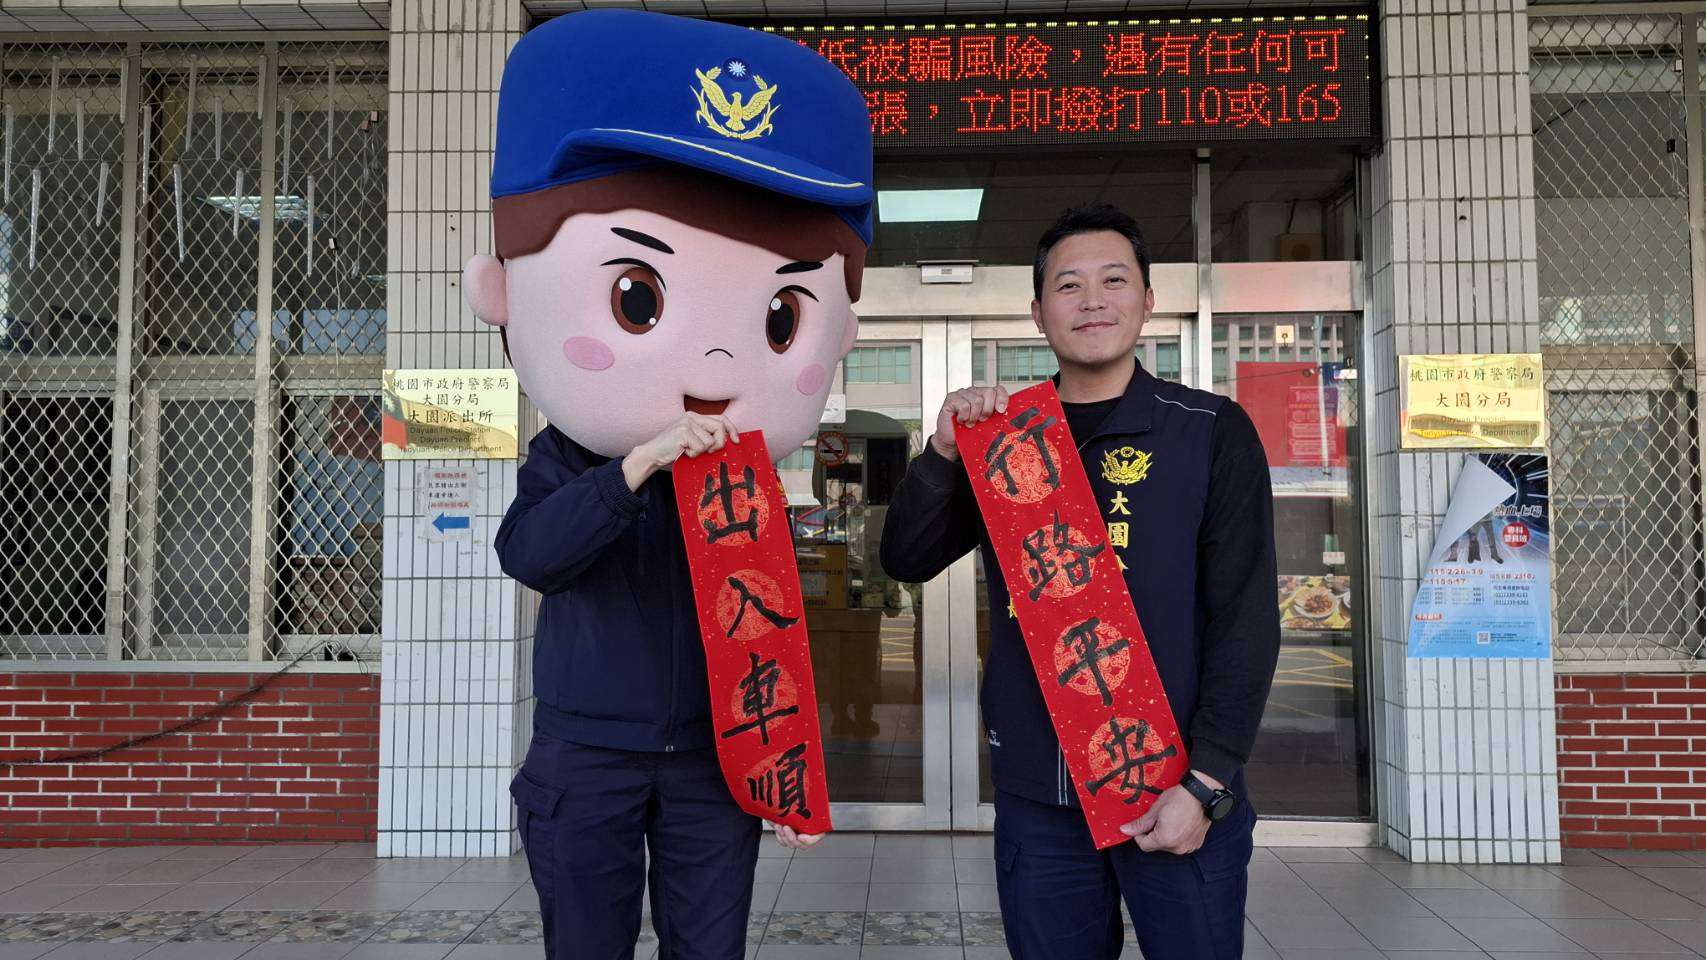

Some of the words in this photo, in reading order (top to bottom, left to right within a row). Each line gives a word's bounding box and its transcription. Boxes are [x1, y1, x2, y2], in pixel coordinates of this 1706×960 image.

[799, 30, 1345, 83] 低被騙風險，遇有任何可
[1410, 367, 1534, 382] 桃園市政府警察局
[393, 377, 509, 391] 桃園市政府警察局
[423, 393, 479, 406] 大園分局
[1436, 392, 1511, 408] 大園分局
[408, 409, 494, 424] 大園派出所
[984, 406, 1177, 804] 行路平安
[700, 461, 811, 820] 出入車順
